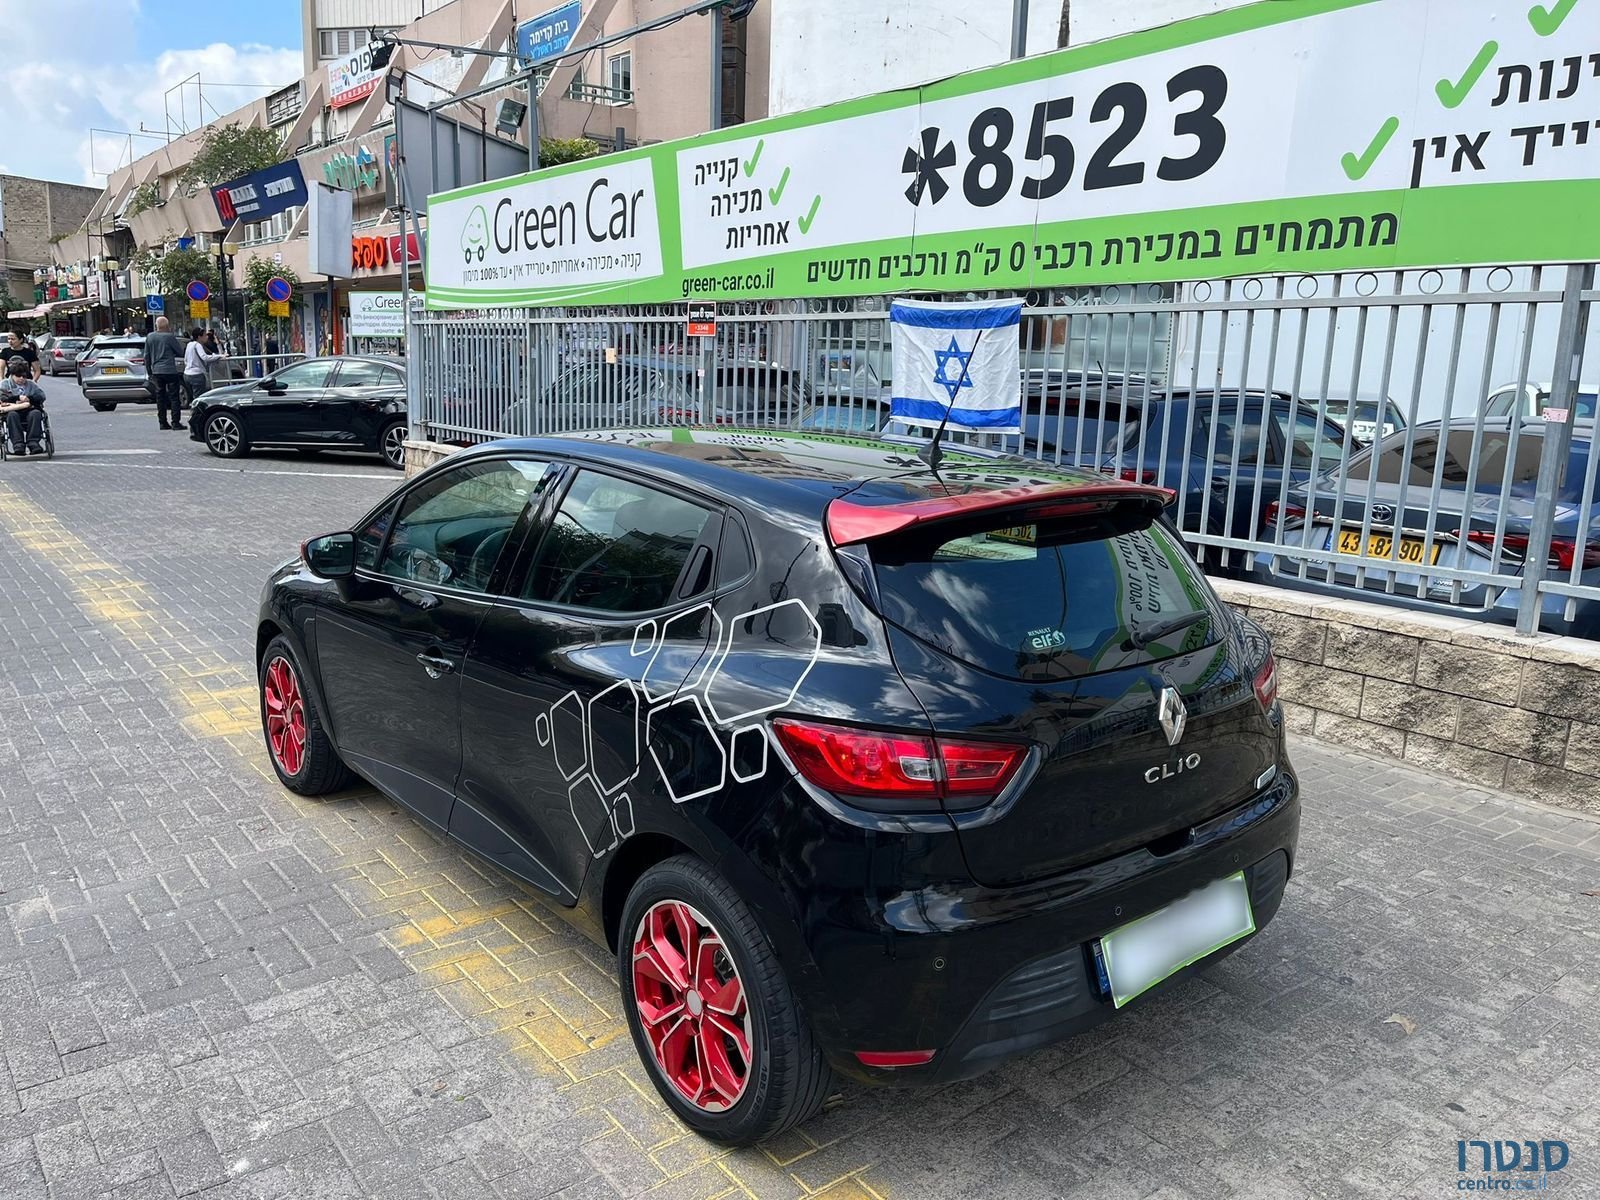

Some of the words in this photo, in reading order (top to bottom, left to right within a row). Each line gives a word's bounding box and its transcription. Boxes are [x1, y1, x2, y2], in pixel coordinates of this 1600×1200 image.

[529, 25, 553, 46] קדימה
[554, 20, 569, 36] בית
[350, 51, 372, 77] פוס
[695, 157, 739, 187] קנייה
[1409, 131, 1491, 189] אין
[494, 197, 576, 254] Green
[586, 178, 644, 242] Car
[711, 188, 762, 217] מכירה
[726, 220, 790, 250] אחריות
[1101, 229, 1222, 266] במכירת
[1235, 212, 1398, 256] מתמחים
[525, 261, 545, 276] טרייד
[551, 258, 580, 274] אחריות
[587, 255, 613, 271] מכירה
[620, 252, 642, 272] קניה
[878, 251, 948, 279] ורכבים
[1009, 241, 1026, 272] 0
[1033, 241, 1093, 271] רכבי
[480, 267, 499, 280] 100%
[682, 267, 774, 298] green-car.co.il
[807, 258, 871, 283] חדשים
[1340, 533, 1361, 552] 43
[1143, 752, 1201, 784] CLIO
